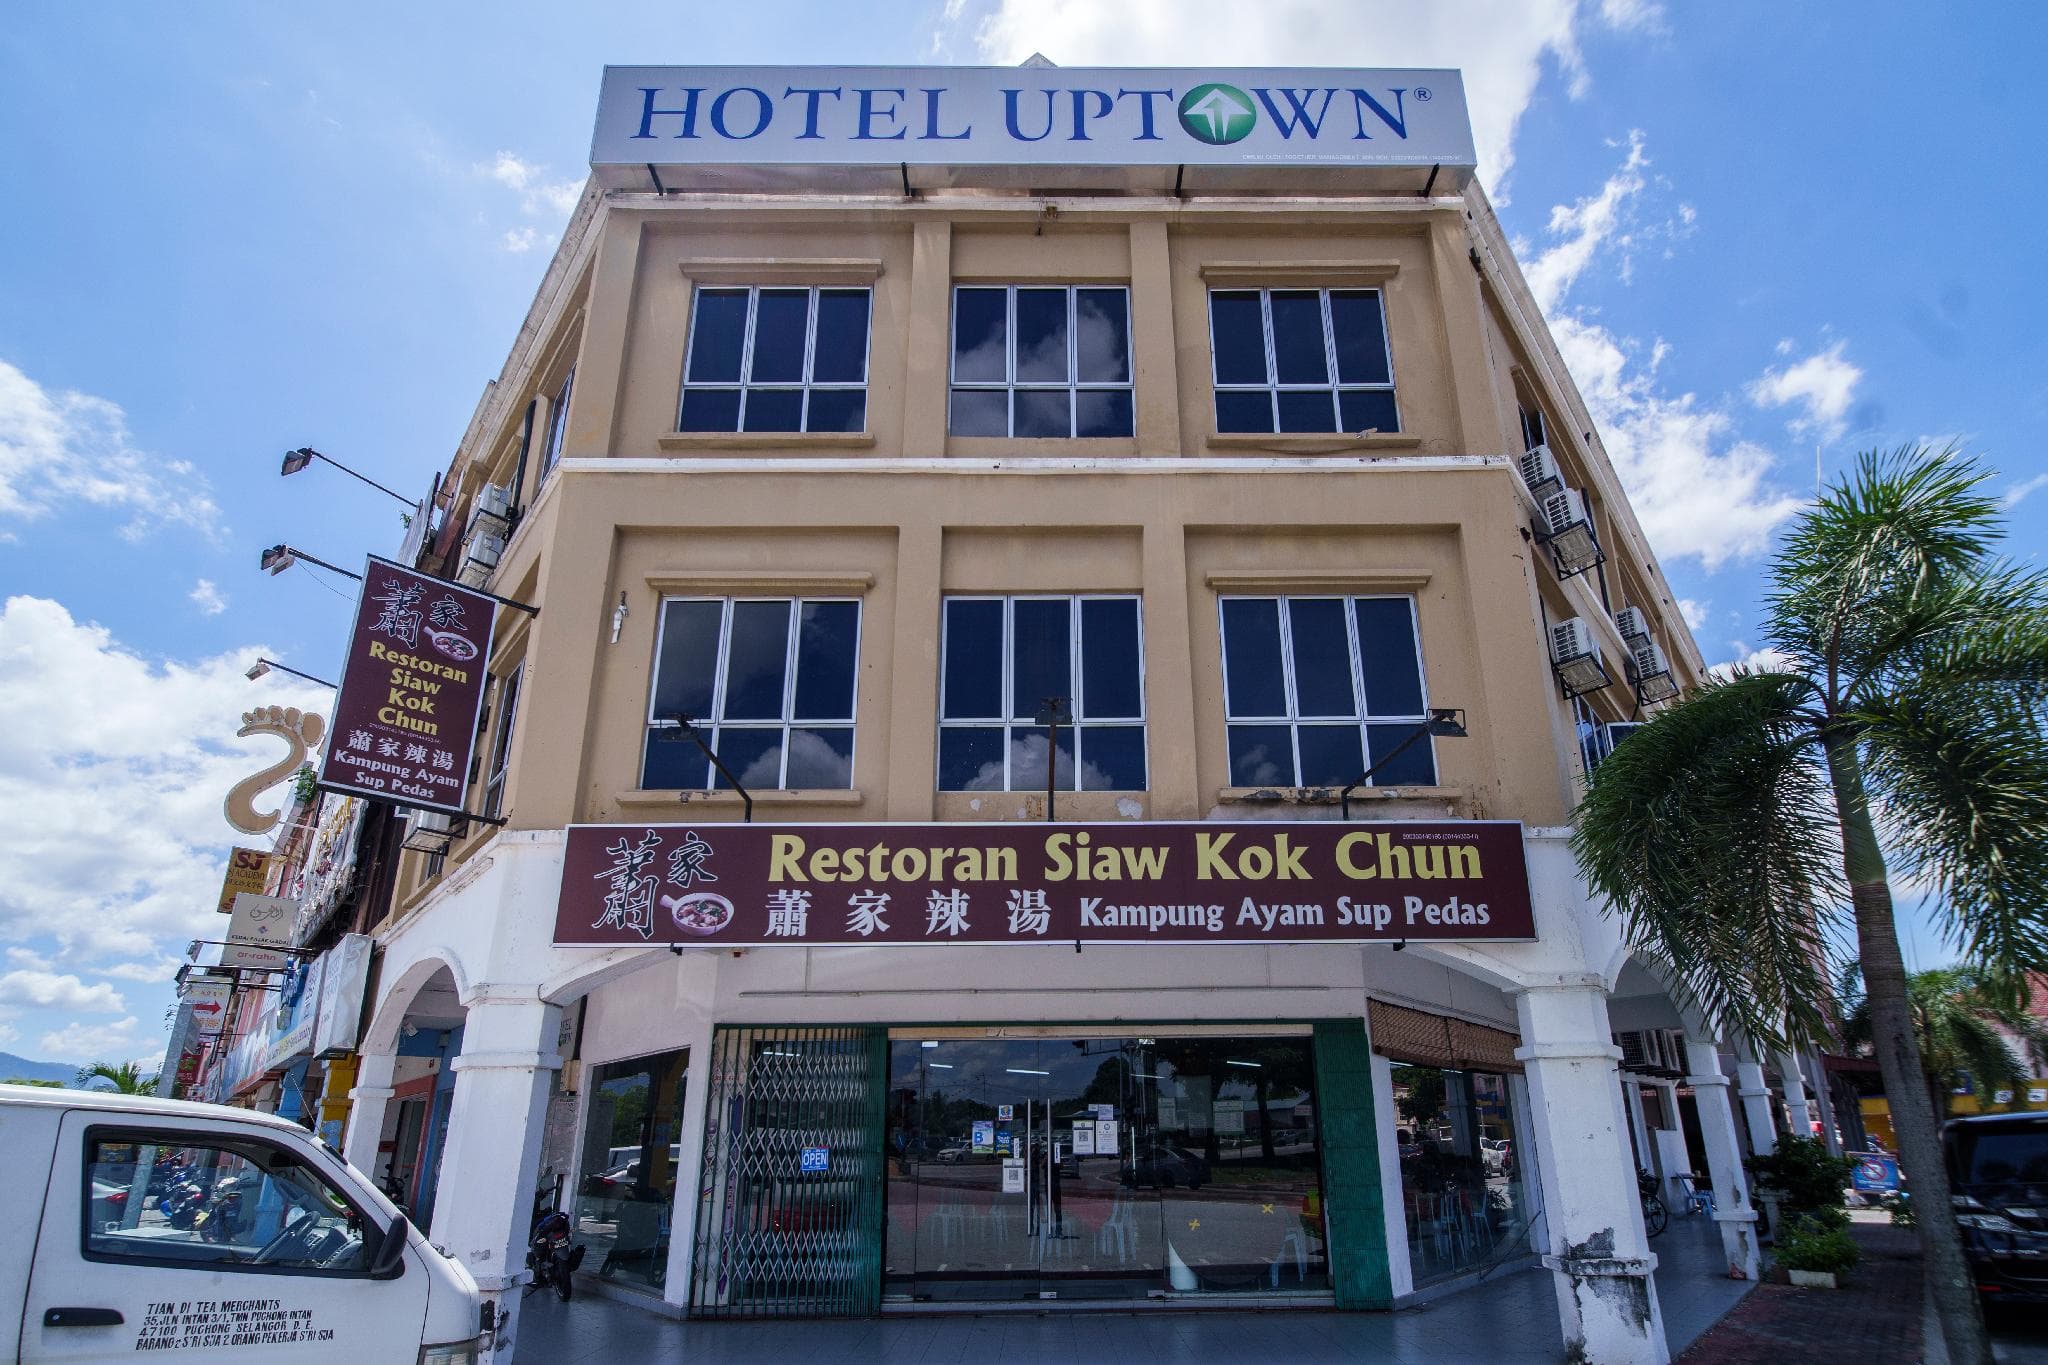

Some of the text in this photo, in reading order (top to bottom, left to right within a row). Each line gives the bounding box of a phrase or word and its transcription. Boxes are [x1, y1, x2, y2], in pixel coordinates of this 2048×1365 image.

[629, 86, 971, 140] HOTEL
[369, 640, 468, 684] Restoran
[390, 667, 442, 696] Siaw
[388, 687, 435, 715] Kok
[378, 706, 438, 736] Chun
[334, 749, 459, 789] Kampung Ayam
[355, 771, 435, 799] Sup Pedas
[767, 831, 1483, 883] Restoran Siaw Kok Chun
[1079, 895, 1491, 933] Kampung Ayam Sup Pedas
[803, 1152, 827, 1166] OPEN
[148, 1299, 280, 1315] TIAN DI TEA MERCHANTS
[181, 1313, 209, 1325] INTAN
[250, 1310, 287, 1322] PUCHONG
[289, 1309, 312, 1320] INTAN
[139, 1326, 177, 1337] 47100
[184, 1323, 230, 1335] PUCHONG
[236, 1320, 287, 1332] SELANGOR
[231, 1332, 261, 1345] ORANG
[261, 1330, 298, 1343] PEKERJA
